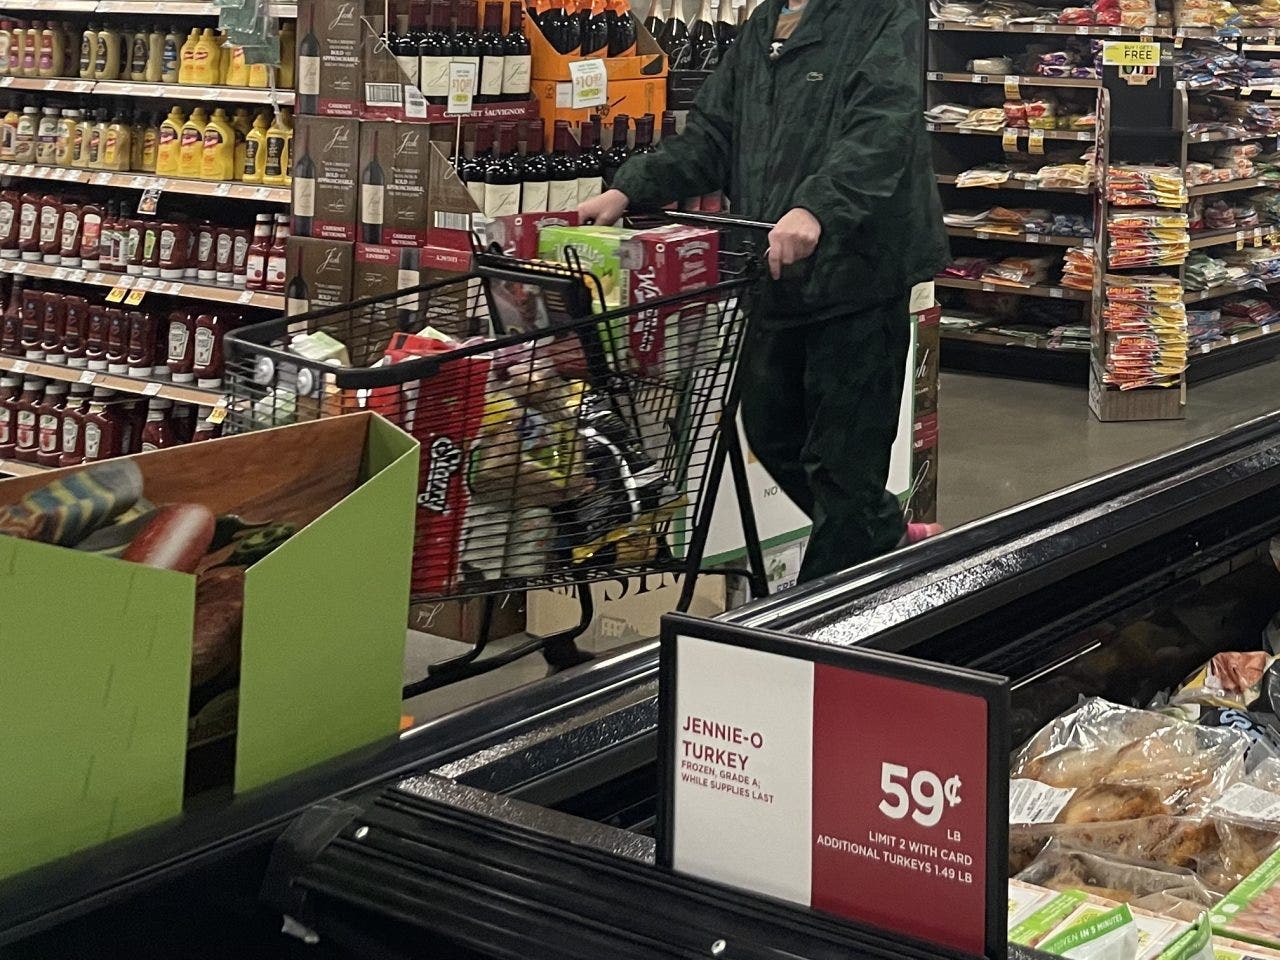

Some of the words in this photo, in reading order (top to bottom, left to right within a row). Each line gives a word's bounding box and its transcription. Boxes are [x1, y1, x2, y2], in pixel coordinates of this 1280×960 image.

[1125, 50, 1152, 60] FREE
[682, 716, 764, 749] JENNIE-O
[682, 740, 749, 771] TURKEY
[681, 760, 718, 777] FROZEN,
[719, 770, 750, 786] GRADE
[681, 773, 709, 788] WHILE
[711, 782, 750, 799] SUPPLIES
[752, 791, 774, 804] LAST
[878, 762, 962, 827] 59¢
[869, 830, 897, 847] LIMIT
[899, 837, 906, 849] 2
[909, 841, 938, 858] WITH
[941, 849, 973, 866] CARD
[947, 829, 961, 842] LB
[817, 834, 881, 860] ADDITIONAL
[883, 851, 932, 874] TURKEYS
[934, 864, 955, 879] 1.49
[958, 870, 973, 884] LB
